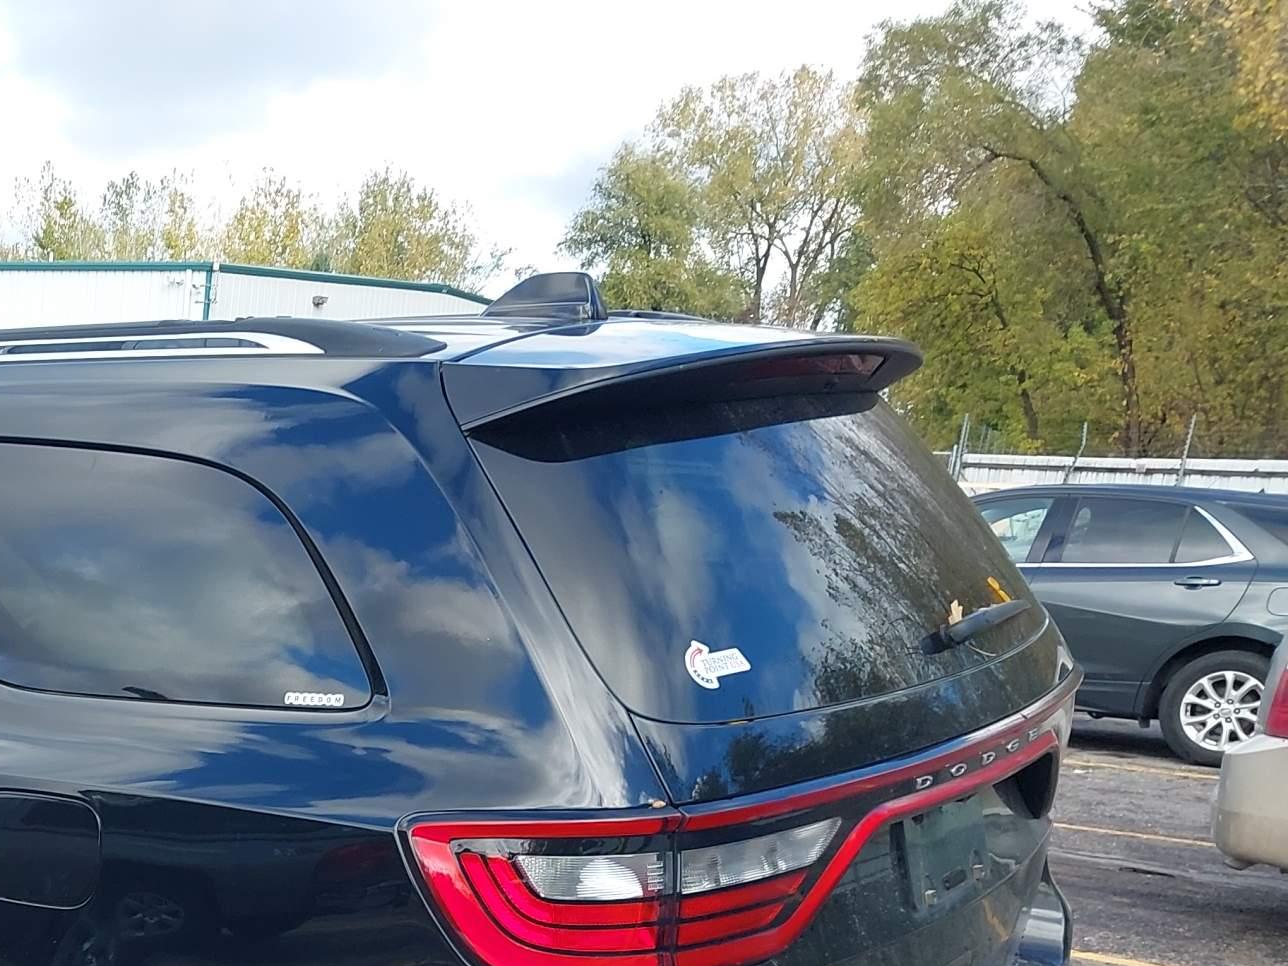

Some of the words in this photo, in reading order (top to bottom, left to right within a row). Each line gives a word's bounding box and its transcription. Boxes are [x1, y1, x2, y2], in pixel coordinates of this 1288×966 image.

[700, 652, 739, 667] TURNING
[703, 662, 729, 674] POINT
[286, 694, 342, 704] FREEDOM
[915, 727, 1040, 790] DODGE
